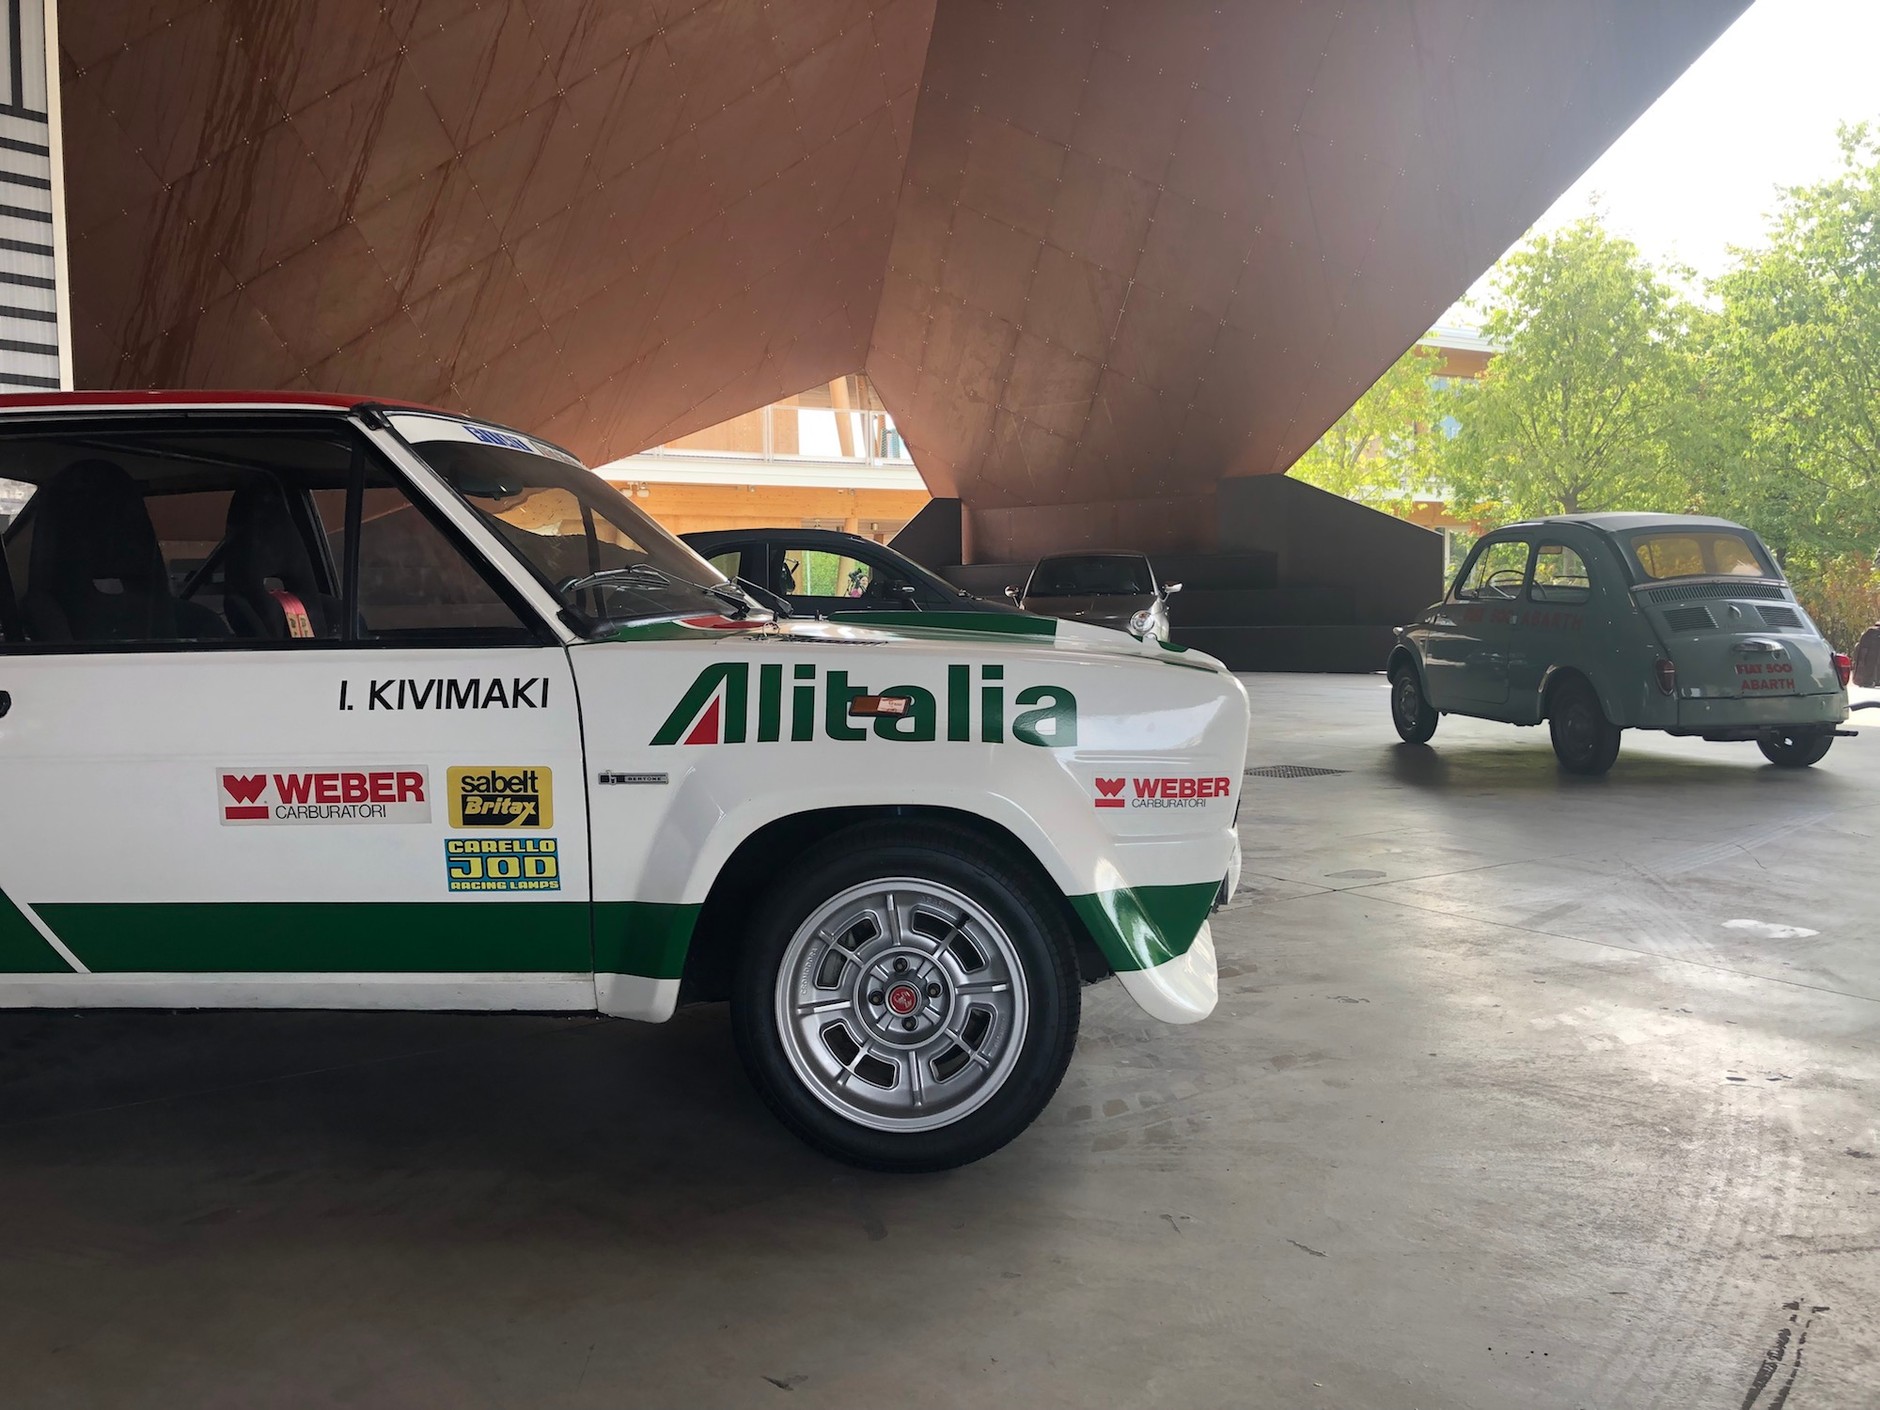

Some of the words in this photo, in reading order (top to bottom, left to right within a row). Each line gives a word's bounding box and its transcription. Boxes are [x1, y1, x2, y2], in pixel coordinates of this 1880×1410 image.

[1767, 663, 1792, 673] 500
[339, 680, 353, 710] I.
[368, 677, 549, 710] KIVIMAKI
[1741, 679, 1795, 690] ABARTH
[650, 661, 1078, 746] Alitalia
[273, 772, 425, 804] WEBER
[461, 770, 538, 793] sabelt
[1133, 777, 1230, 798] WEBER
[275, 804, 386, 819] CARBURATORI
[465, 796, 537, 822] Britax
[1131, 799, 1206, 809] CARBURATORI
[448, 840, 556, 853] CARELLO
[449, 855, 558, 879] JOD
[450, 881, 507, 890] RACING
[510, 880, 560, 890] LAMPS
